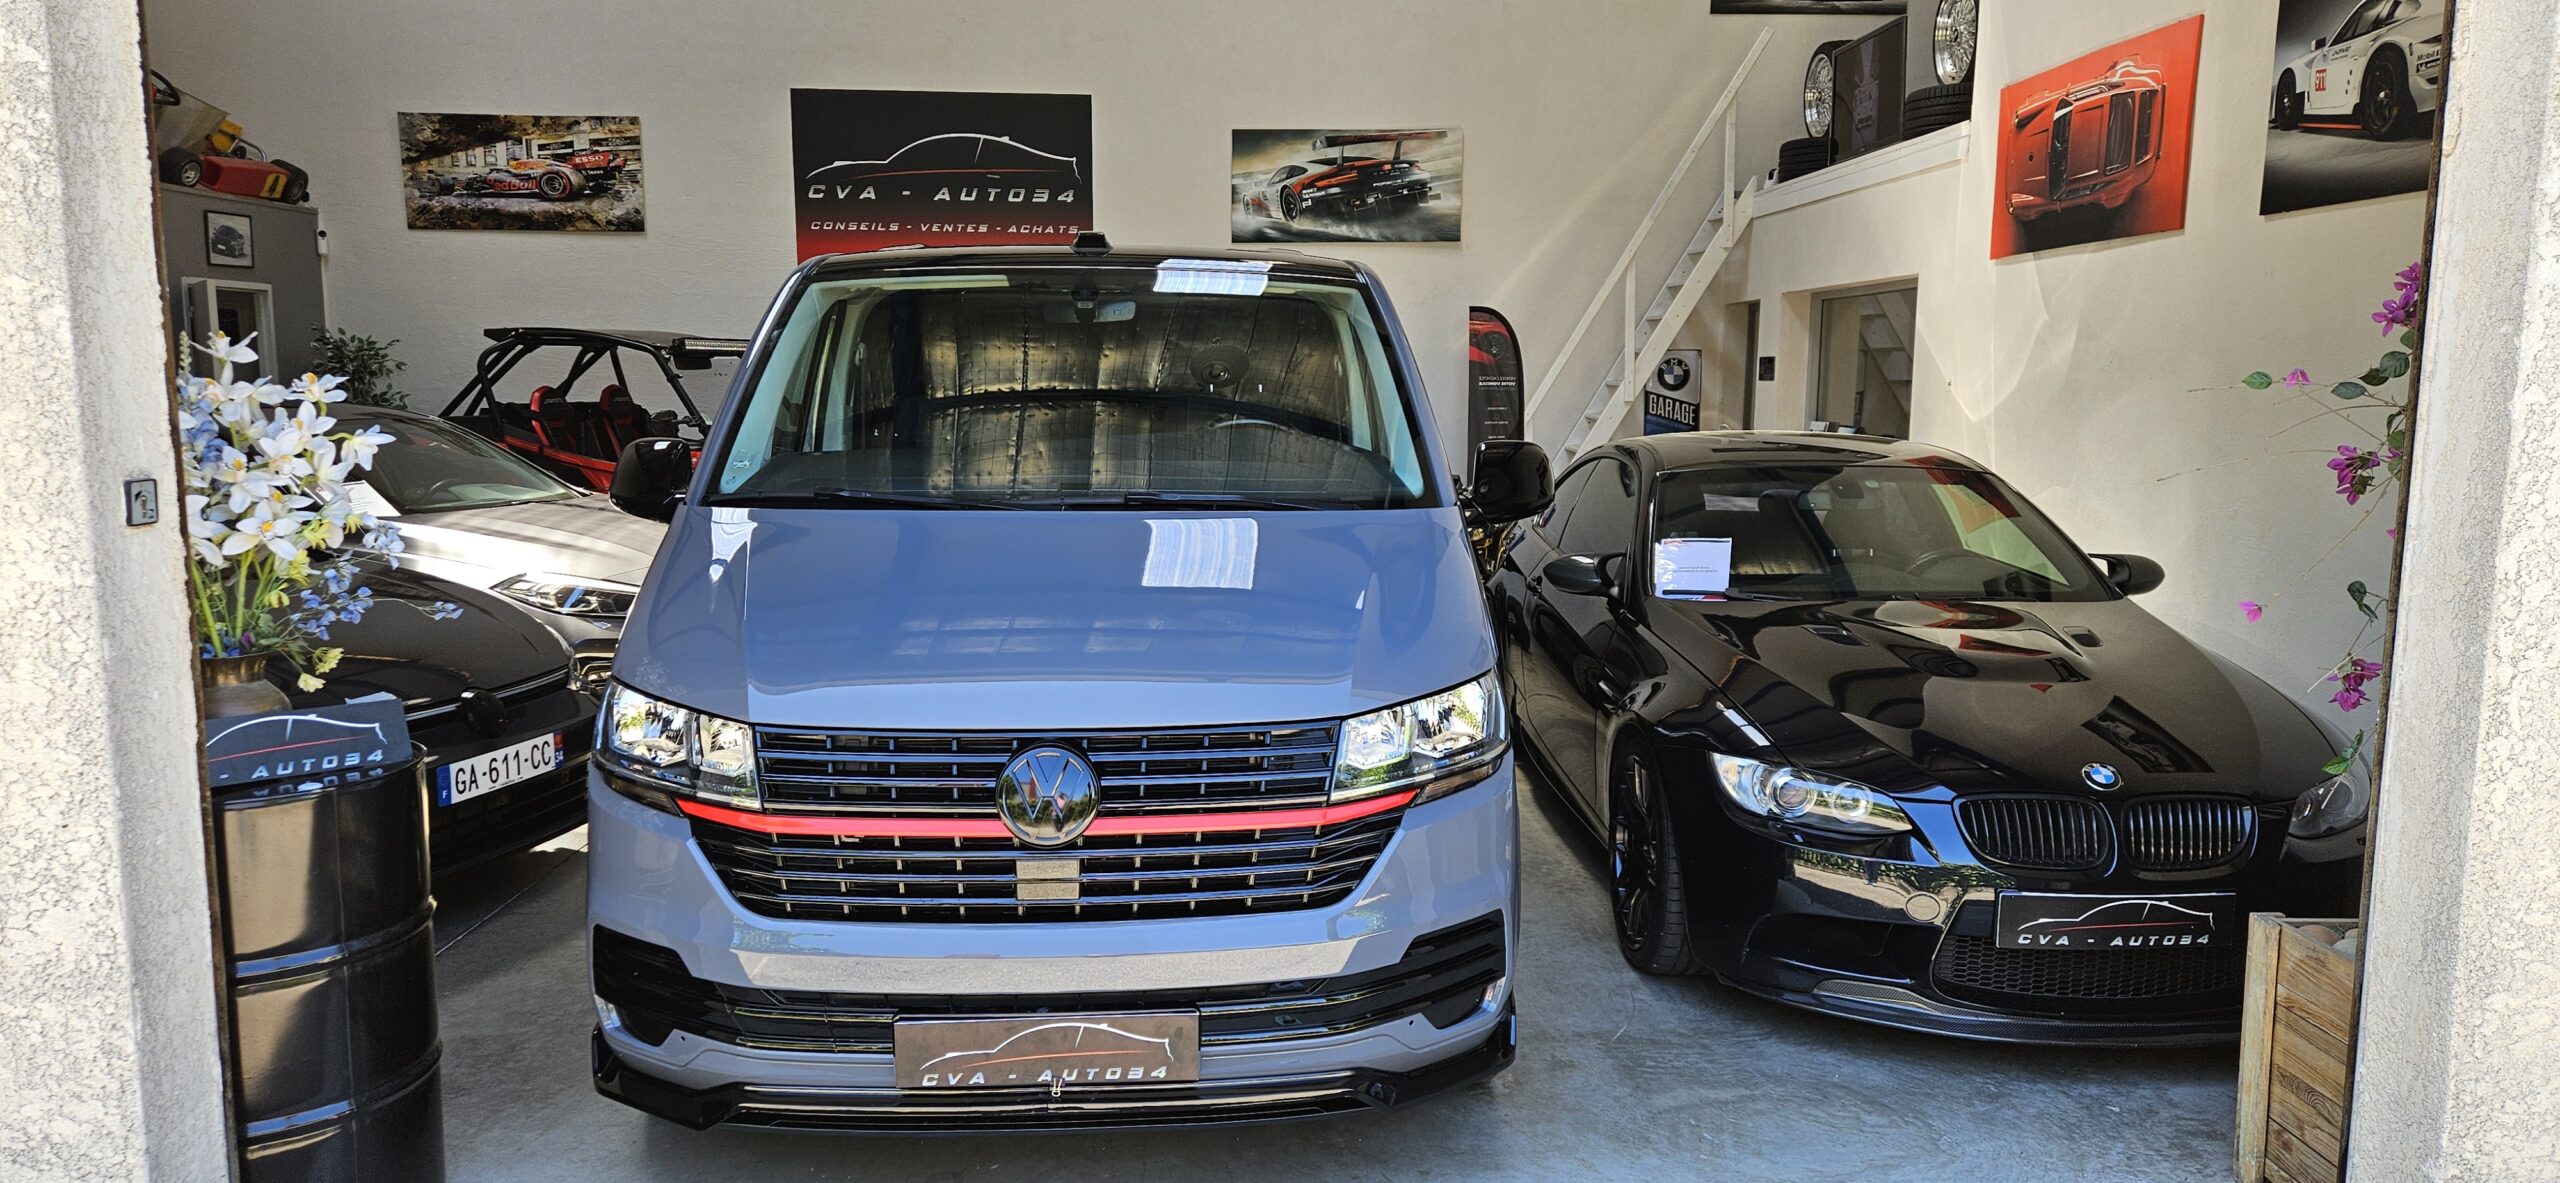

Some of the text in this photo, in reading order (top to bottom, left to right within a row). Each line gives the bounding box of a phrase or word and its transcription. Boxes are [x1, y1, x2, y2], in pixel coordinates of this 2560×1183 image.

[2315, 72, 2326, 89] 911
[807, 184, 877, 200] CVA
[933, 187, 1075, 203] AUTO34
[810, 221, 900, 232] CONSEILS
[920, 223, 989, 233] VENTES
[1007, 225, 1080, 235] ACHATS
[1660, 358, 1689, 371] BMW
[1649, 394, 1696, 426] GARAGE
[251, 750, 384, 780] AUTO34
[555, 751, 564, 763] 34
[455, 740, 552, 795] GA-611-CC
[442, 790, 448, 799] F
[2018, 934, 2070, 946] CVA
[2110, 934, 2210, 946] AUTO34
[922, 1072, 985, 1087] CVA
[1037, 1066, 1168, 1083] AUTO34
